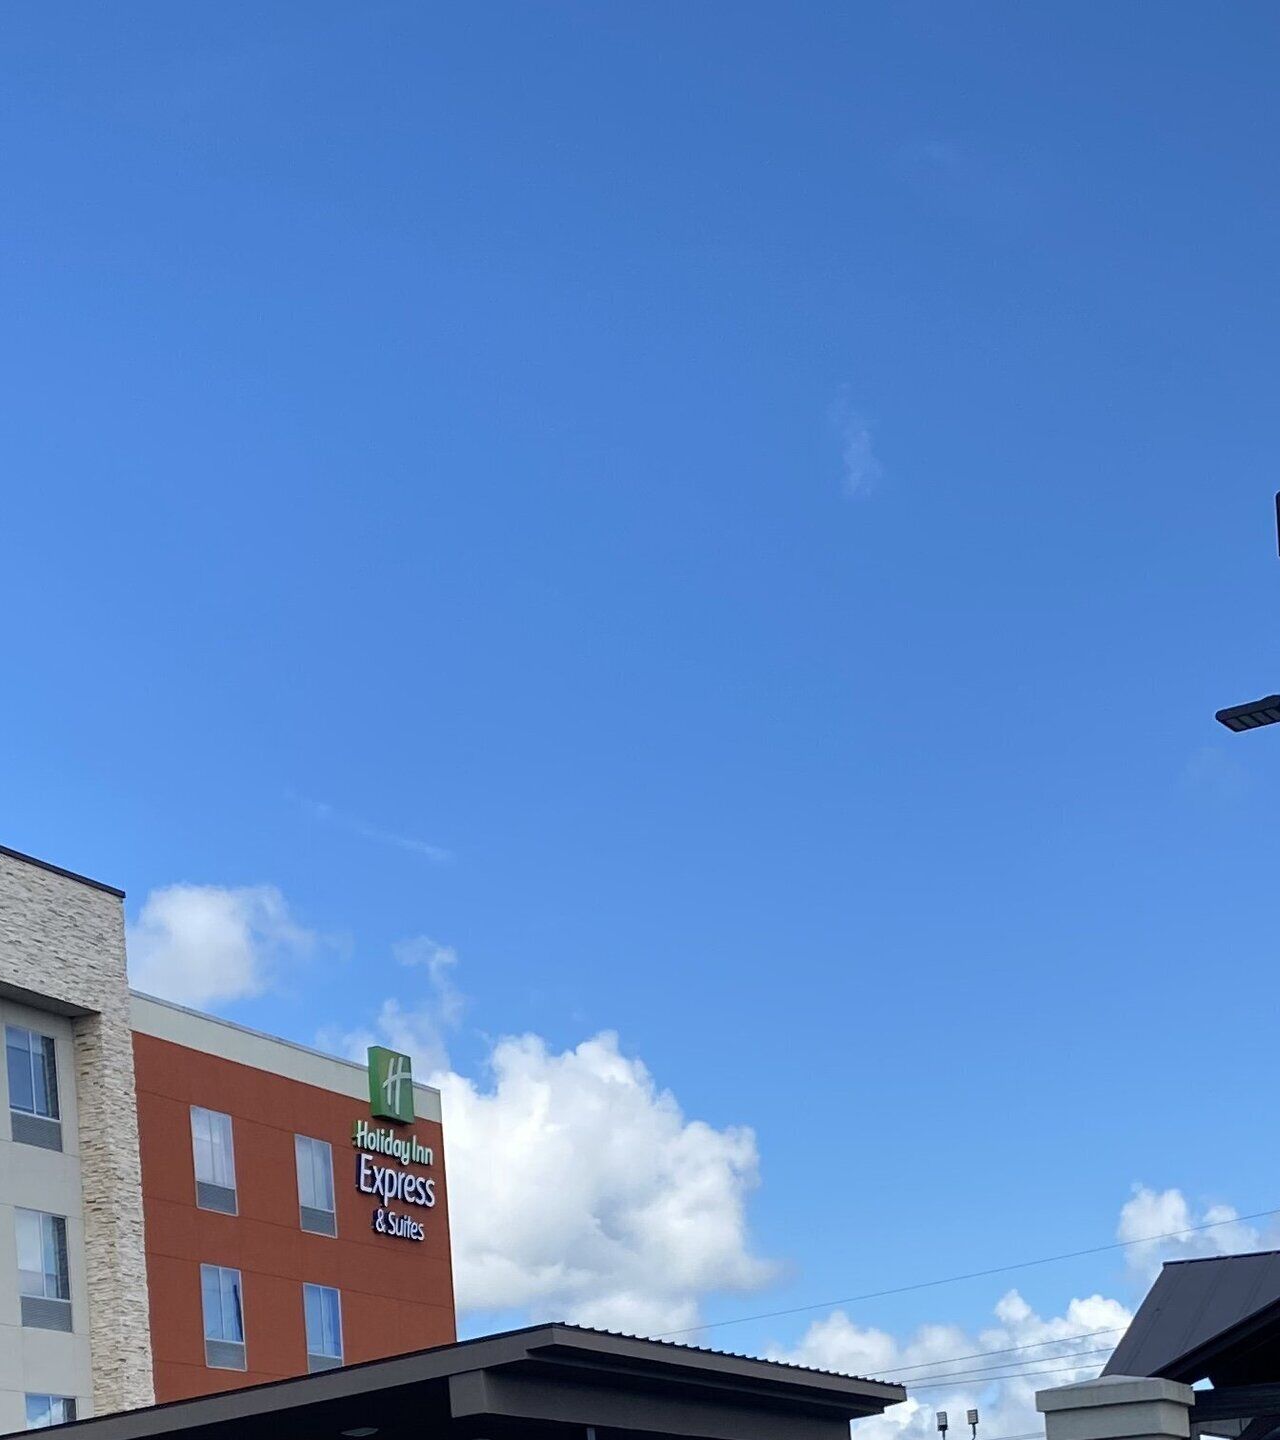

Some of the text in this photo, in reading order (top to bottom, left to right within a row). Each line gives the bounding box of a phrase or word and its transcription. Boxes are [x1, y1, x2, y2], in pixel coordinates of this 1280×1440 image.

[356, 1120, 433, 1166] Holiday Inn
[360, 1153, 436, 1207] Express
[375, 1208, 424, 1240] & Suites
